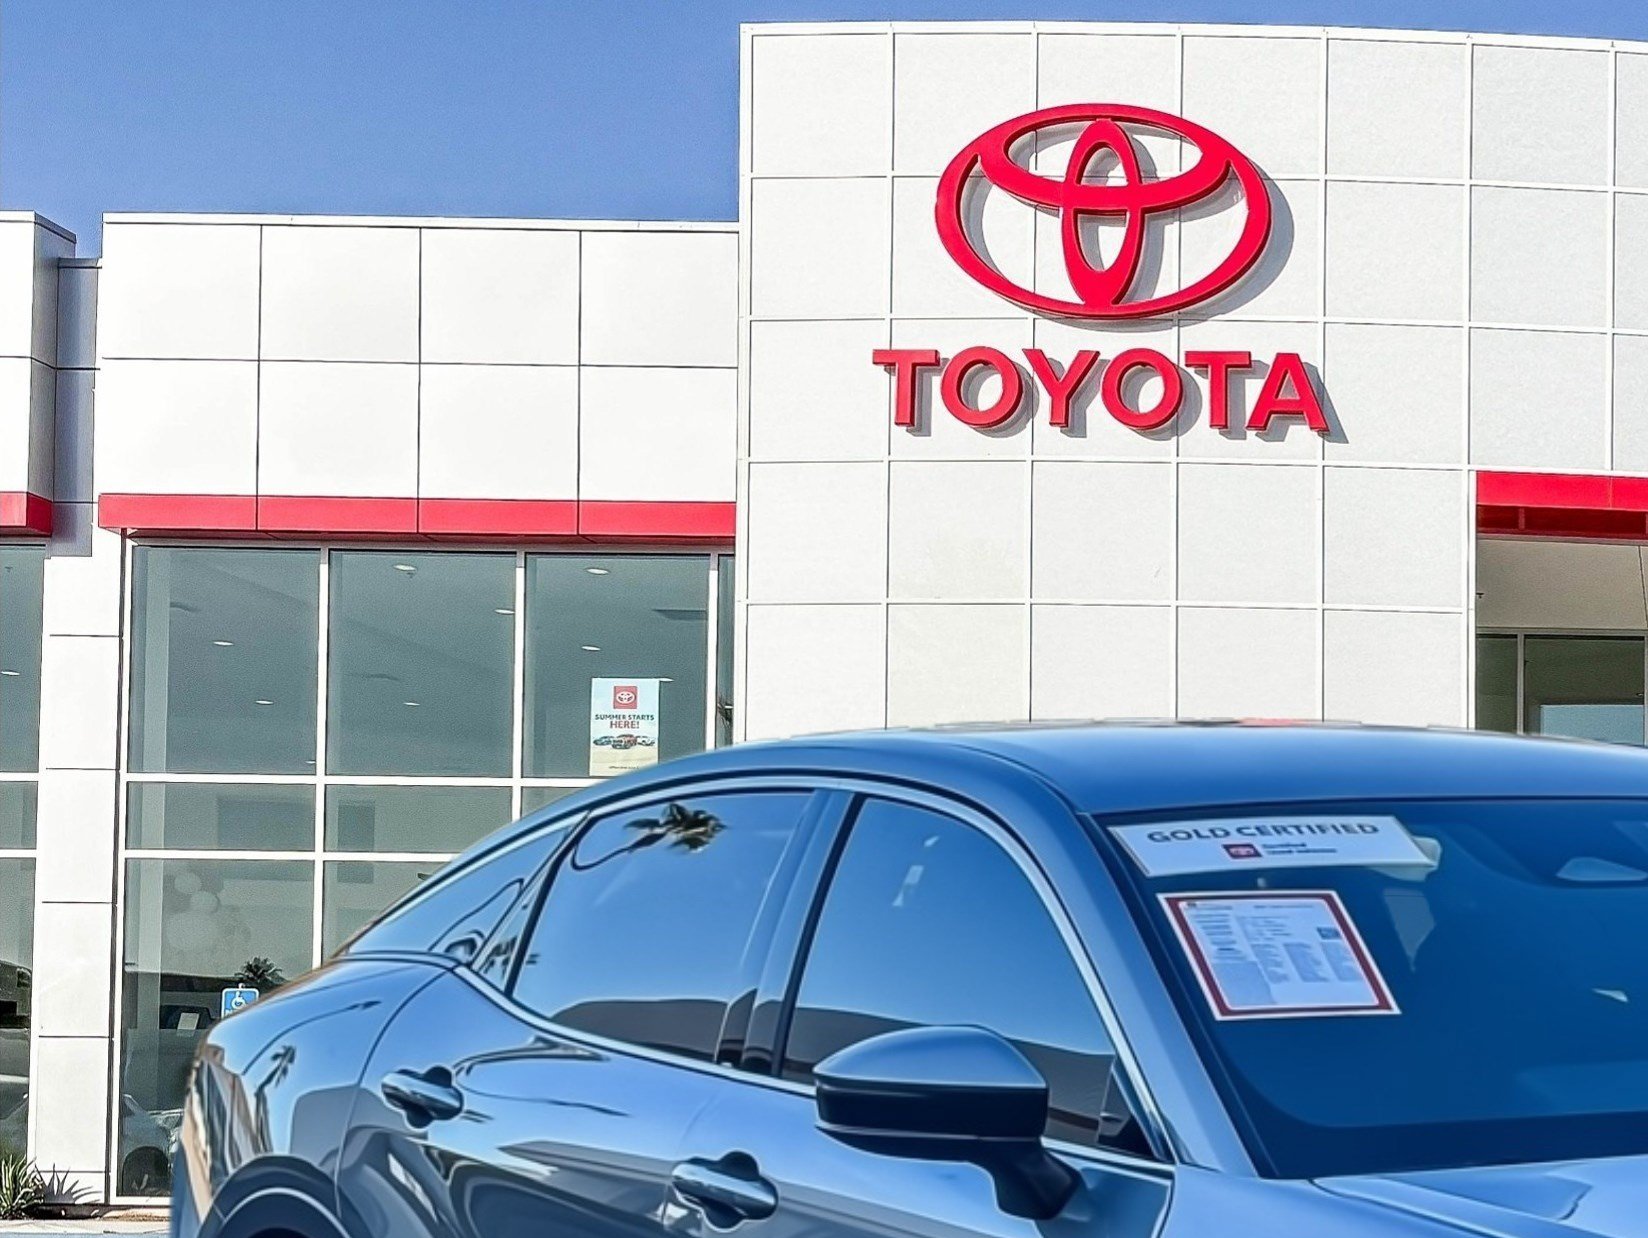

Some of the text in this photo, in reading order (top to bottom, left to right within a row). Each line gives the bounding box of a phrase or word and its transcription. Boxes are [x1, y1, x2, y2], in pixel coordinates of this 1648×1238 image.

[872, 345, 1329, 432] TOYOTA
[609, 720, 640, 729] HERE!
[1147, 822, 1380, 843] GOLD CERTIFIED
